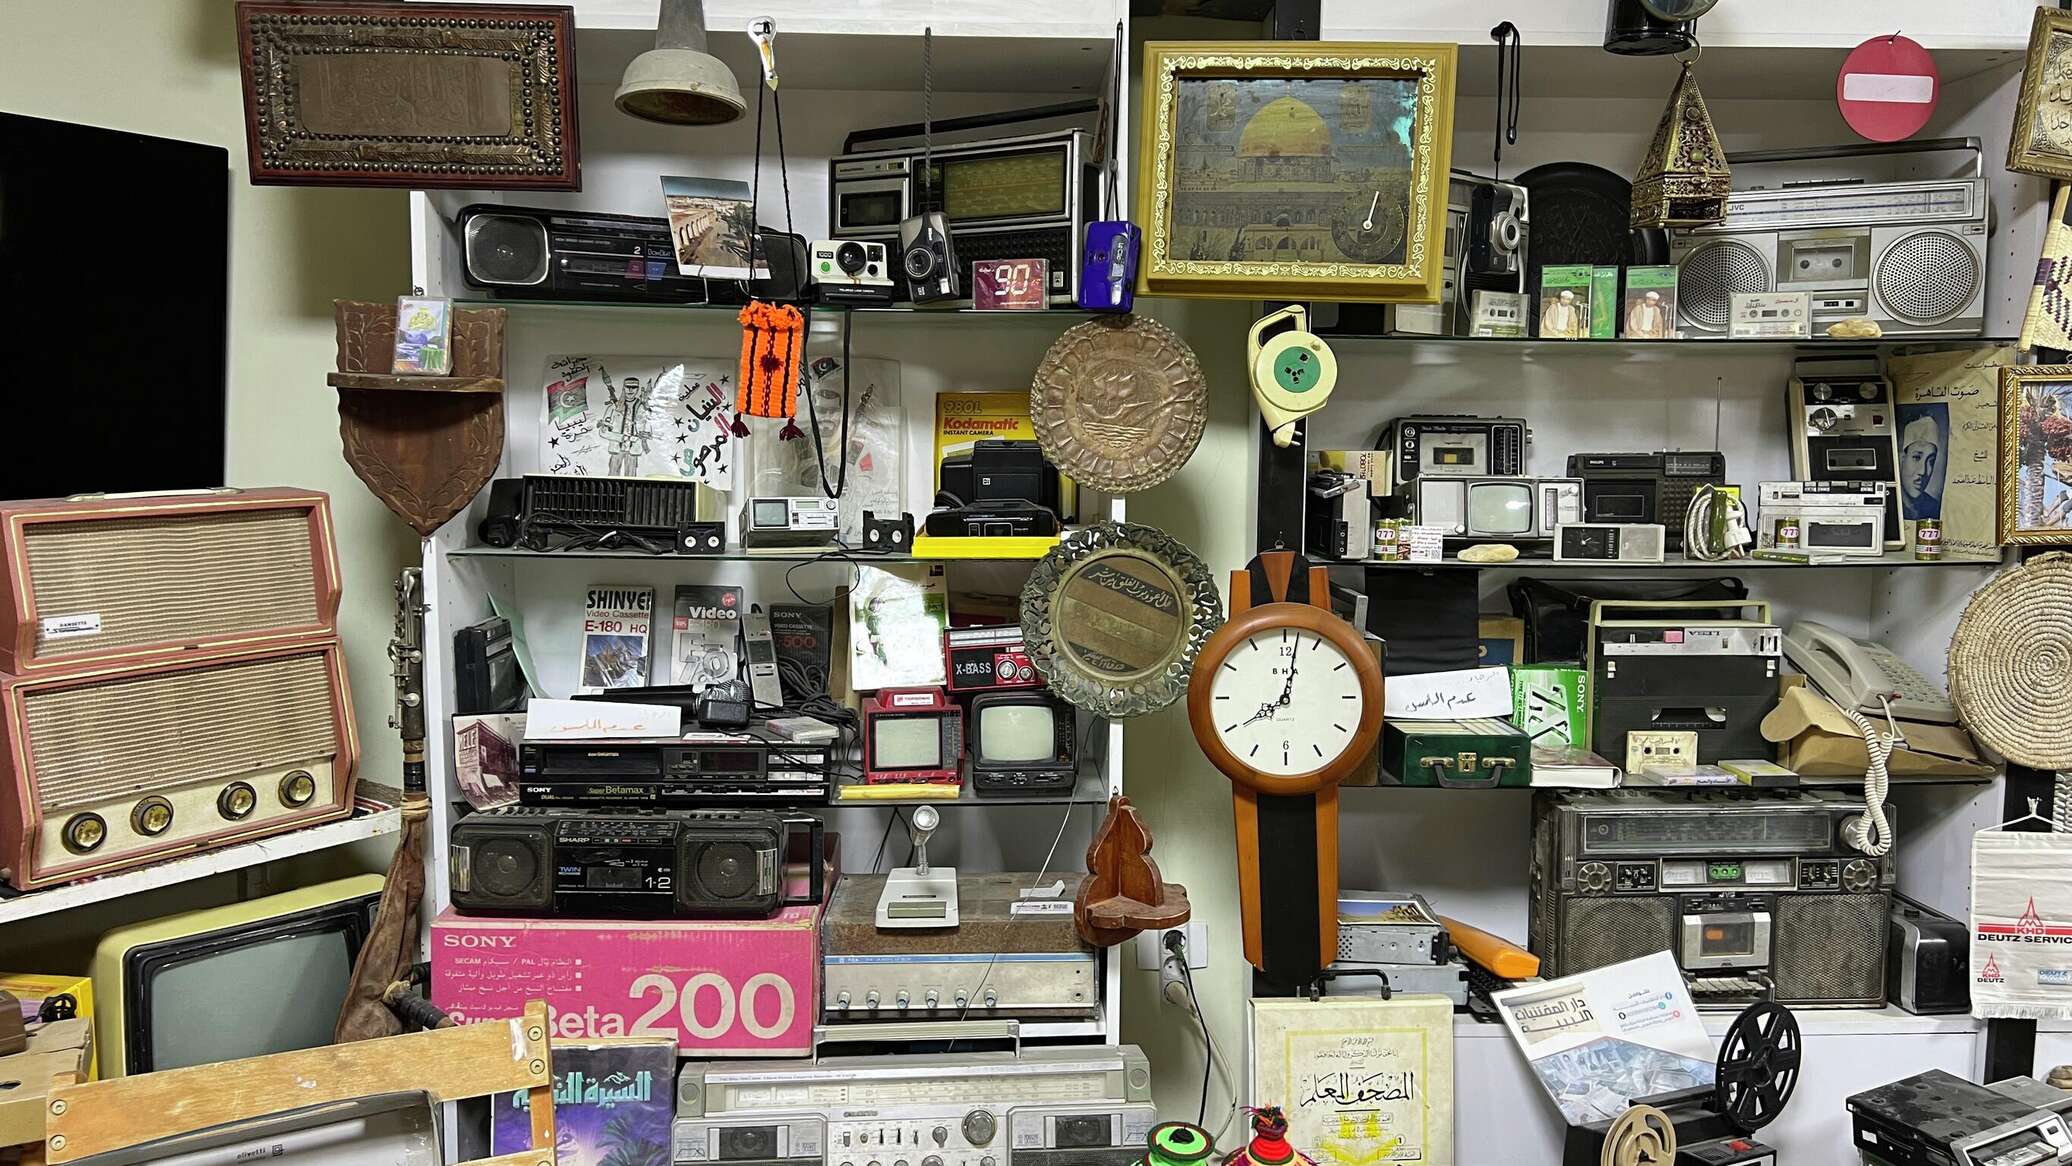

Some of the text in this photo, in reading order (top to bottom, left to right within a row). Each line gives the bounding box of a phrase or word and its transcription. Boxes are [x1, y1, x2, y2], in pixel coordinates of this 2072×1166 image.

[994, 264, 1031, 296] 90
[944, 400, 982, 414] 980L
[943, 417, 1018, 431] Kodamatic
[1377, 530, 1394, 538] 777
[1922, 530, 1939, 539] 777
[586, 610, 649, 619] Video Cassette
[689, 606, 737, 620] Video
[773, 611, 802, 619] SONY
[584, 620, 648, 634] E-180 HQ
[1279, 647, 1292, 657] 12
[955, 662, 992, 676] X-BASS
[1577, 675, 1586, 713] SONY
[1283, 741, 1290, 751] 6
[605, 785, 644, 795] Betamax
[1977, 934, 2021, 942] DEUTZ
[2016, 927, 2044, 935] KHD
[444, 934, 517, 948] SONY
[455, 957, 481, 965] SECAM
[628, 972, 795, 1040] 200
[1515, 997, 1586, 1021] دار المقتنيات
[583, 1070, 653, 1109] السيرة
[1300, 1071, 1415, 1108] المصحف المعلم
[237, 1147, 267, 1160] olivetti
